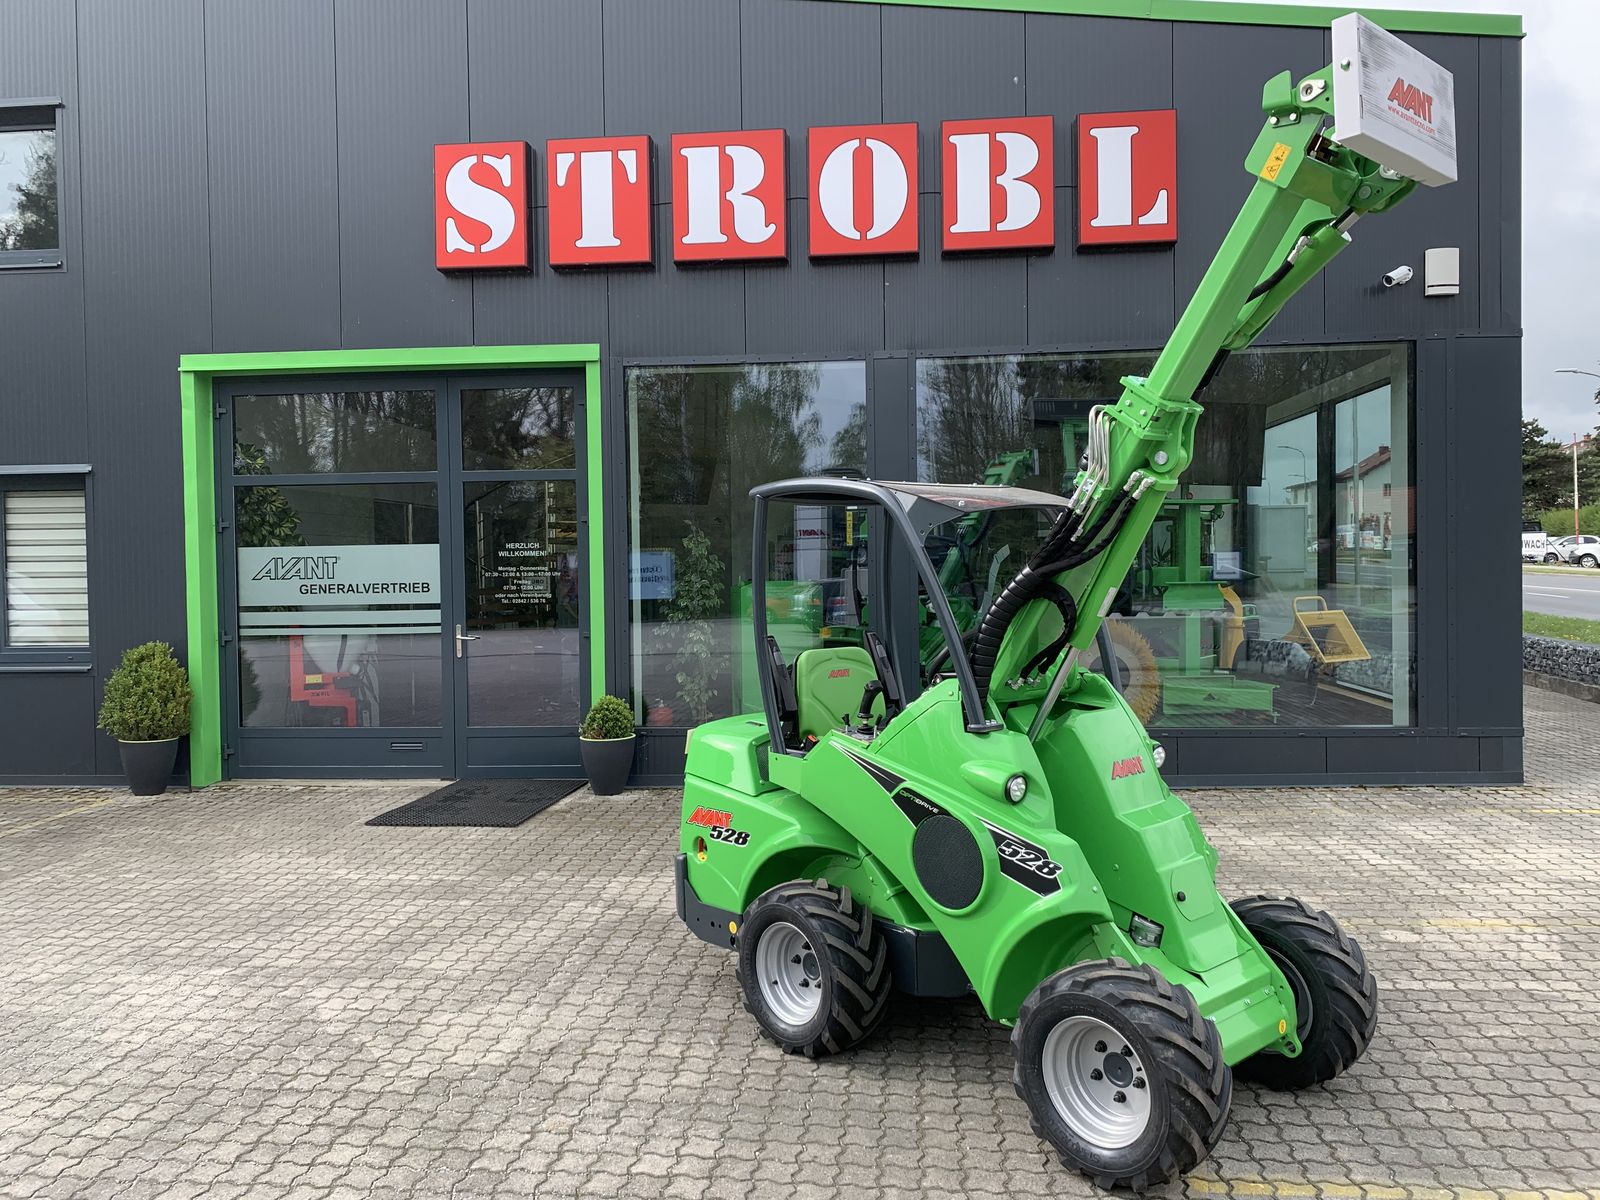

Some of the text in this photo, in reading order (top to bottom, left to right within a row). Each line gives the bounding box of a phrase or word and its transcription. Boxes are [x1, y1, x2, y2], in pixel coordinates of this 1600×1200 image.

[1387, 77, 1433, 124] AVANT
[445, 125, 1168, 253] STROBL
[1522, 540, 1546, 549] WACH
[252, 556, 338, 580] AVANT
[299, 583, 430, 595] GENERALVERTRIEB
[1111, 756, 1145, 780] AVANT
[686, 805, 733, 829] AVANT
[709, 825, 750, 847] 528
[997, 840, 1063, 878] 528
